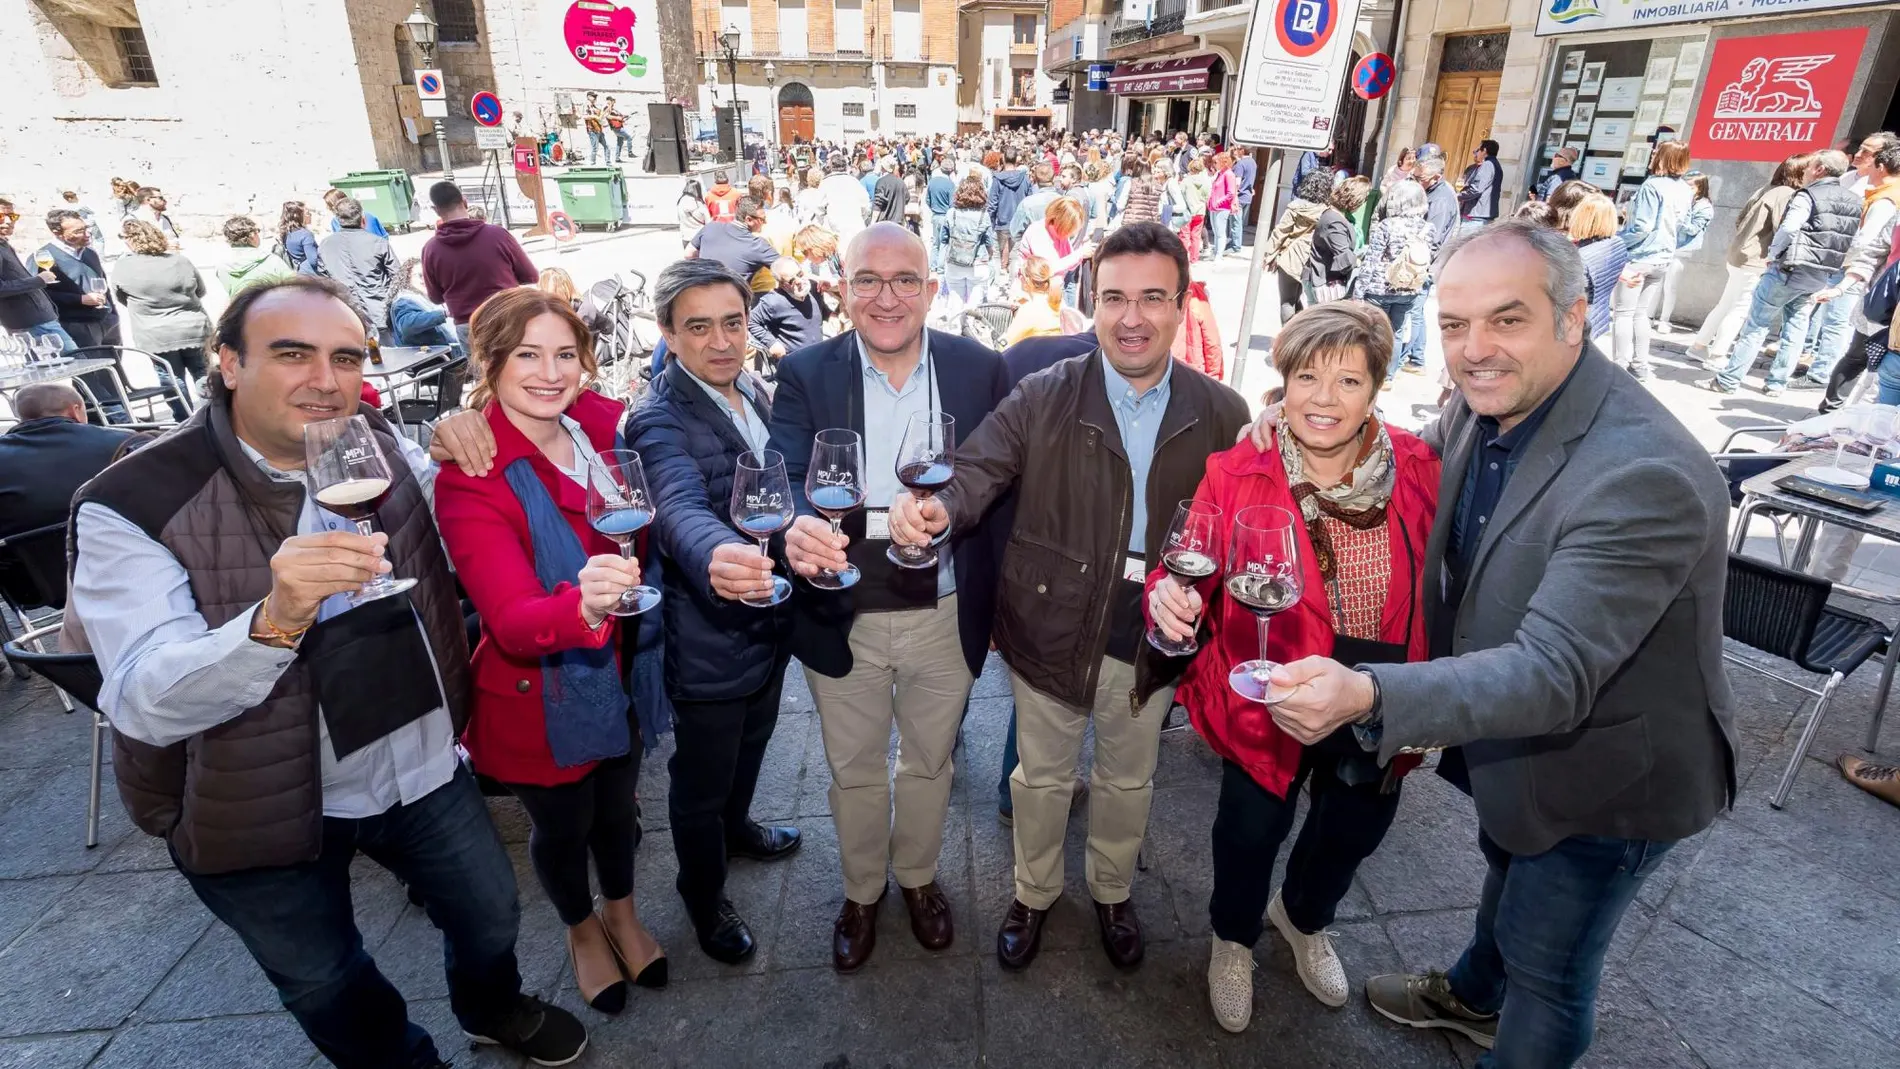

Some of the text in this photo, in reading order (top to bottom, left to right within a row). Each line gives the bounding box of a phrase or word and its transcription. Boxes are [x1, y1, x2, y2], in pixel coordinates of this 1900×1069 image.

[1632, 0, 1729, 20] INMOBILIARIA
[1708, 121, 1818, 142] GENERALI
[344, 447, 365, 460] MPV
[1246, 561, 1267, 574] MPV
